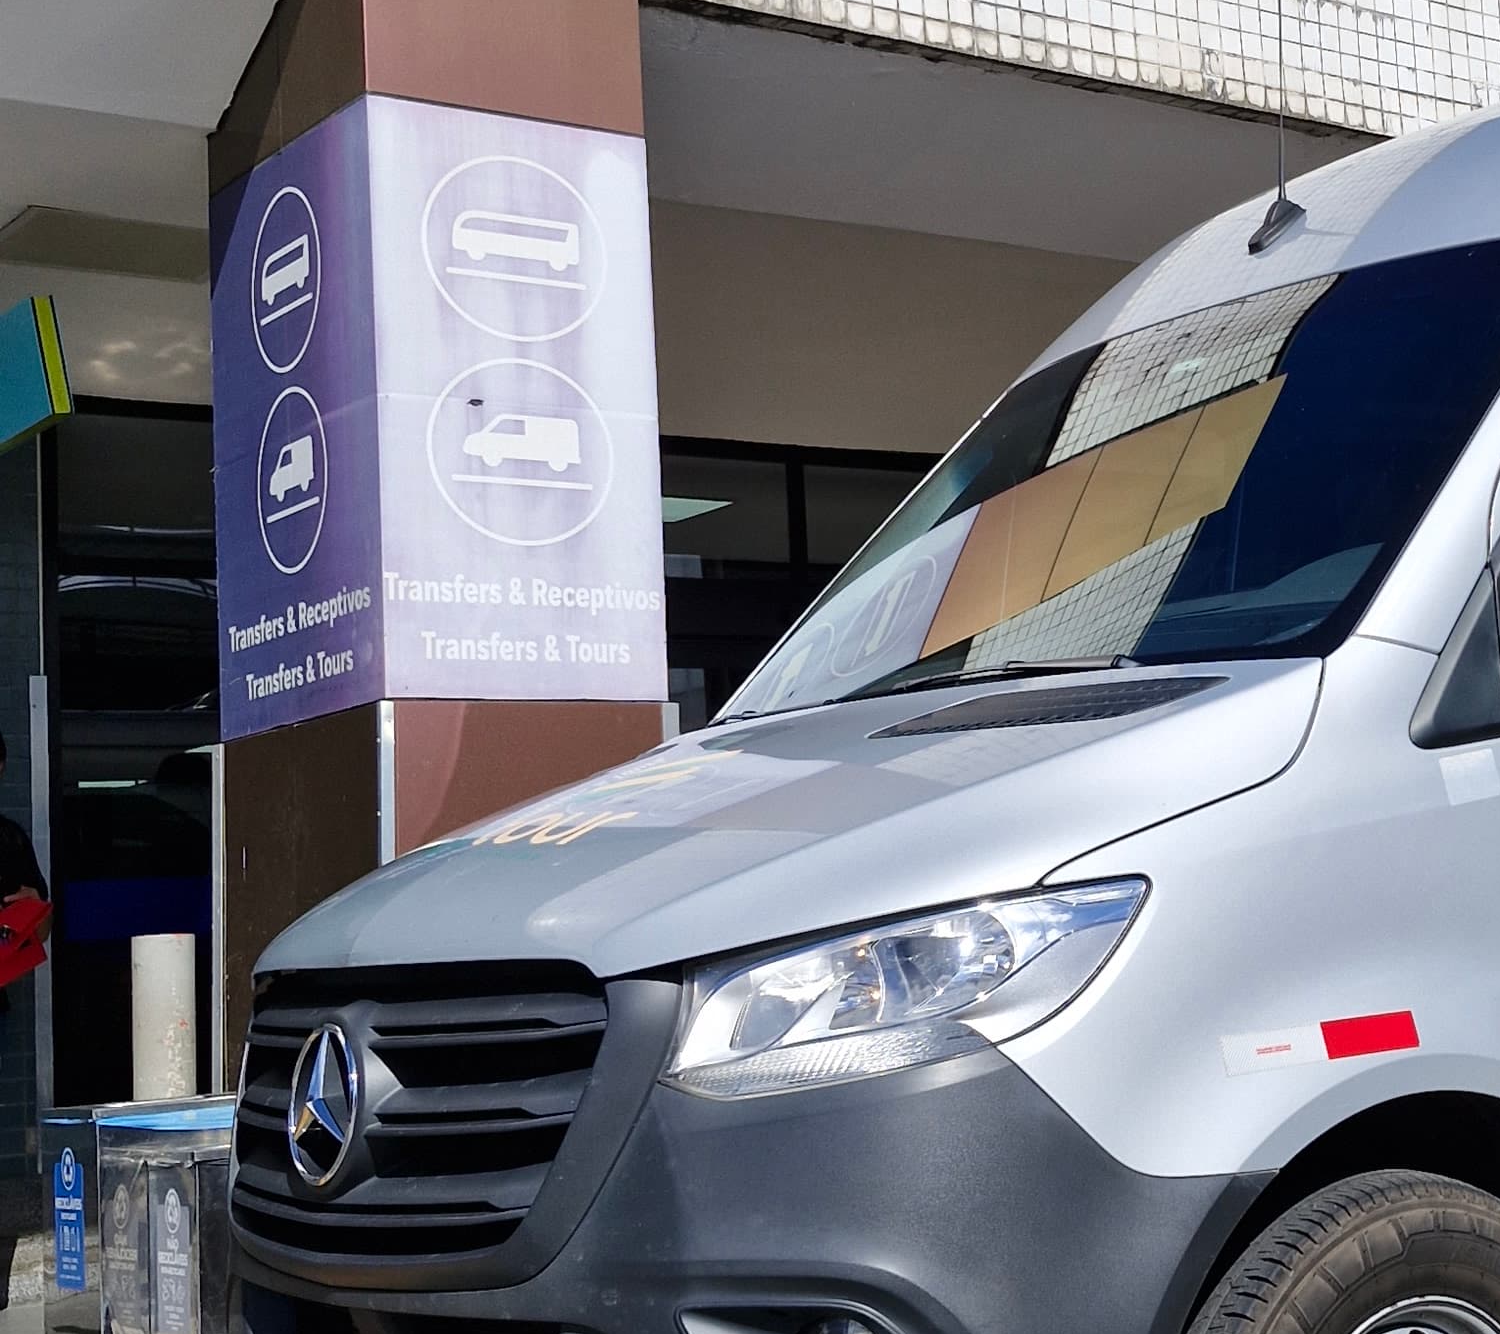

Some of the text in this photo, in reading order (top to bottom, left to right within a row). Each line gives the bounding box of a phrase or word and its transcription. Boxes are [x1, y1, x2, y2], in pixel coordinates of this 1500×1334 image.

[384, 571, 661, 615] Transfers & Receptivos
[229, 585, 372, 653] Transfers & Receptivos
[421, 630, 631, 664] Transfers & Tours
[246, 649, 354, 701] Transfers & Tours
